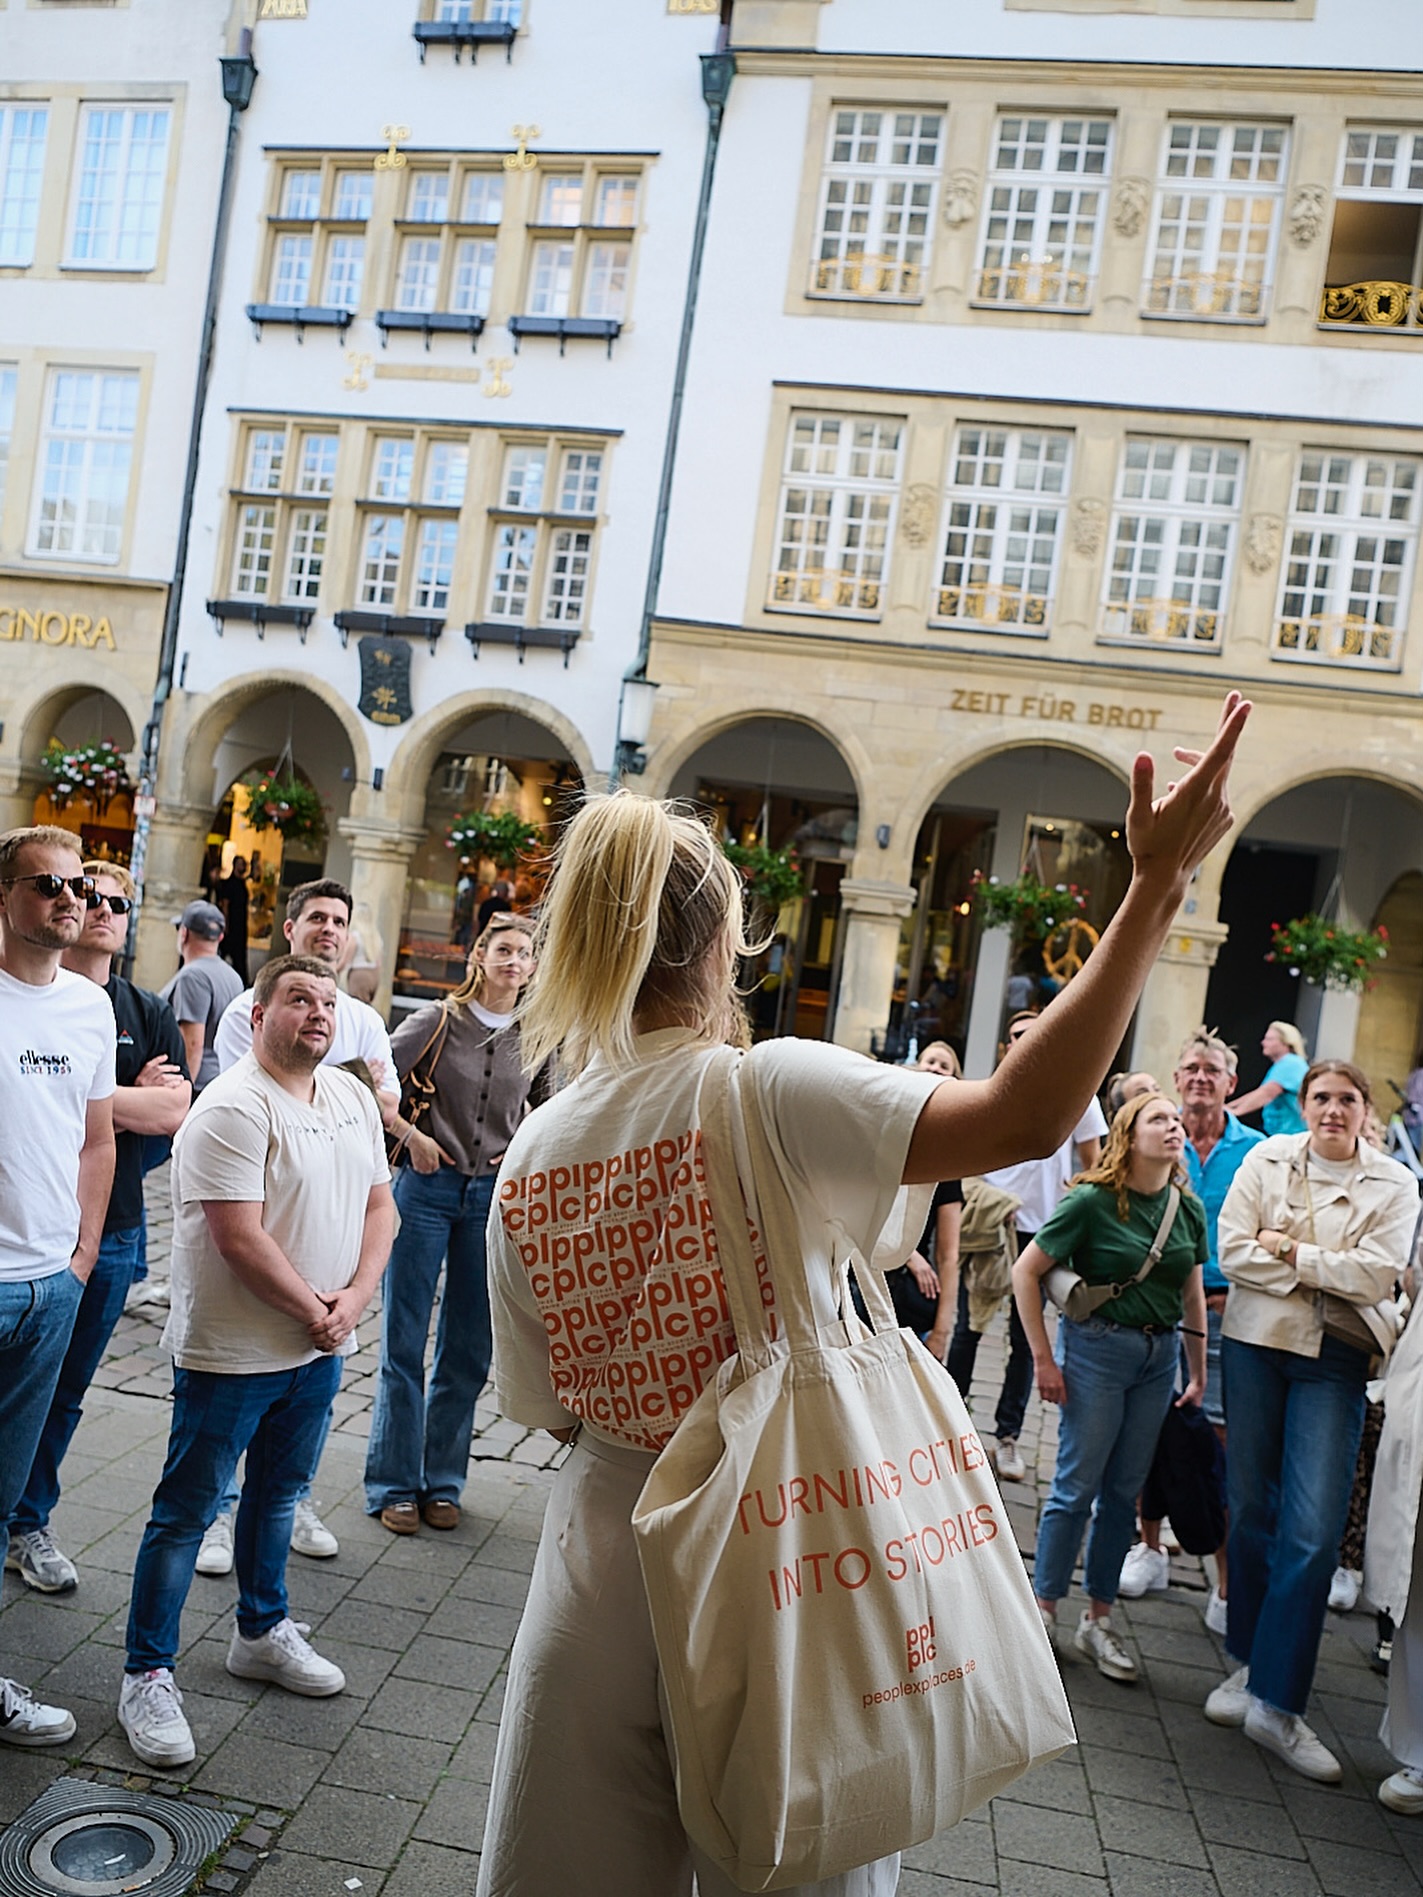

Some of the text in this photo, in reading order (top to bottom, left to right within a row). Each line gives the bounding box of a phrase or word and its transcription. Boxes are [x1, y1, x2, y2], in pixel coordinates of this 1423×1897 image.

[0, 608, 116, 651] GNORA
[951, 689, 1163, 730] ZEIT FÜR BROT
[19, 1049, 70, 1066] ellesse
[47, 1064, 72, 1076] 1959
[738, 1432, 986, 1535] TURNING CITIES
[768, 1504, 999, 1611] INTO STORIES
[906, 1616, 936, 1651] ppl
[907, 1642, 938, 1673] plc
[862, 1658, 977, 1709] peoplexplaces.de
